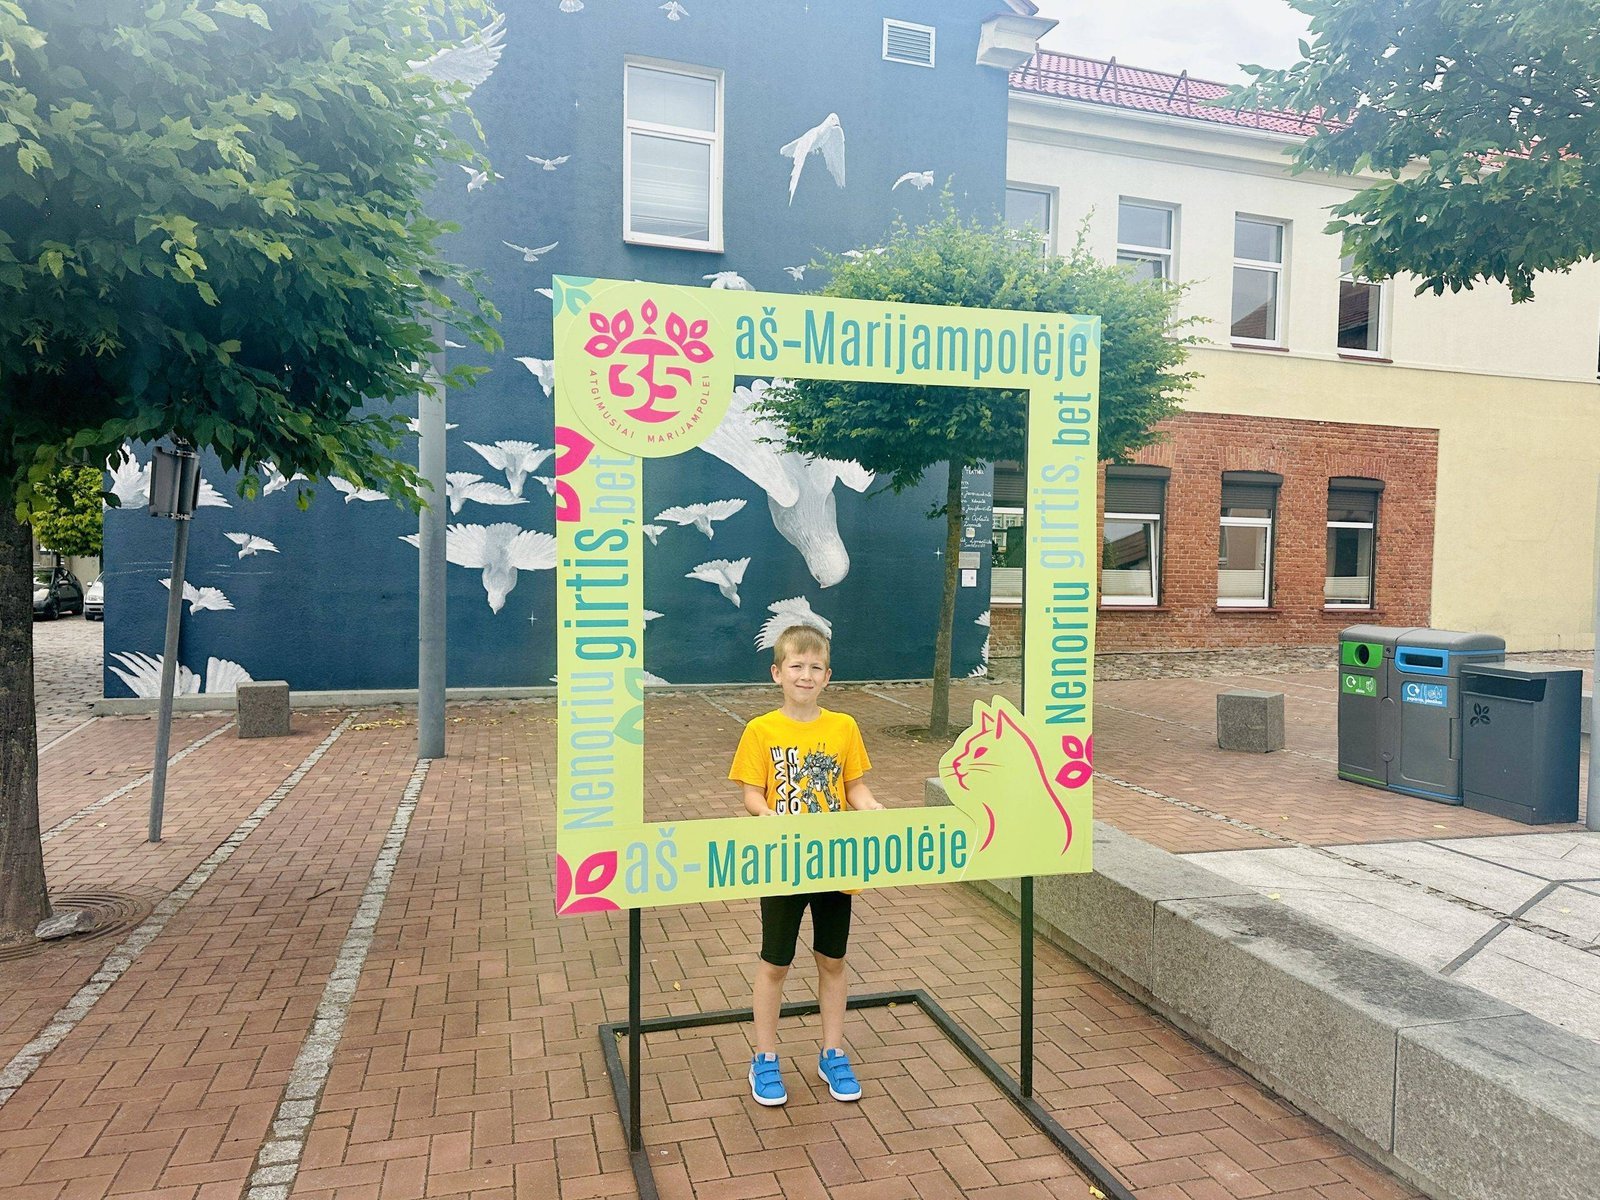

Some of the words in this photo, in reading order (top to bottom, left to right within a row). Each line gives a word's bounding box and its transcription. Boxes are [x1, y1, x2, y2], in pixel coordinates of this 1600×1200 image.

[589, 369, 634, 438] ATGIMUSIAI
[647, 375, 710, 443] MARIJAMPOLEI
[1052, 391, 1092, 446] bet
[588, 454, 636, 514] bet
[1033, 455, 1085, 569] girtis,
[563, 518, 637, 660] girtis,
[1045, 582, 1089, 725] Nenoriu
[562, 671, 615, 830] Nenoriu
[770, 746, 786, 815] GAME
[786, 746, 801, 815] OVER
